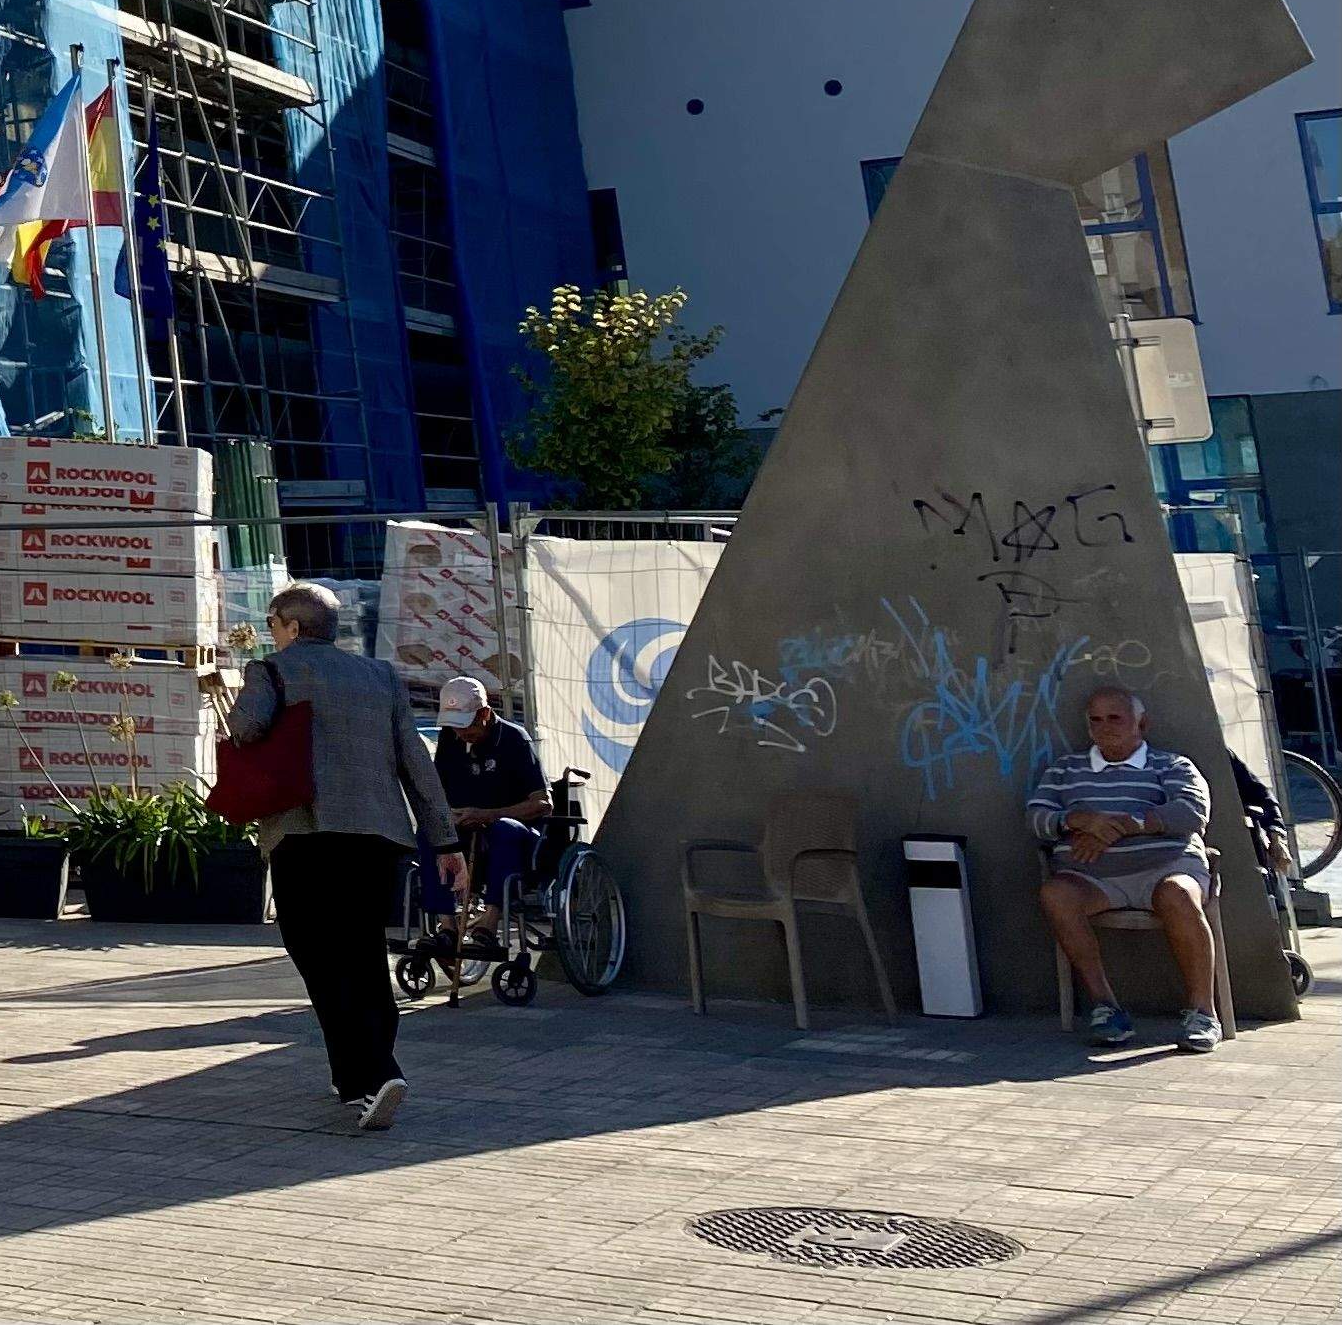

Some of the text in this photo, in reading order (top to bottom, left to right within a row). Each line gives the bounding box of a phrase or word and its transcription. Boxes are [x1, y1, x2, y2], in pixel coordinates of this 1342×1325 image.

[55, 467, 157, 486] ROCKWOOL
[51, 534, 153, 550] ROCKWOOL
[52, 588, 155, 605] ROCKWOOL
